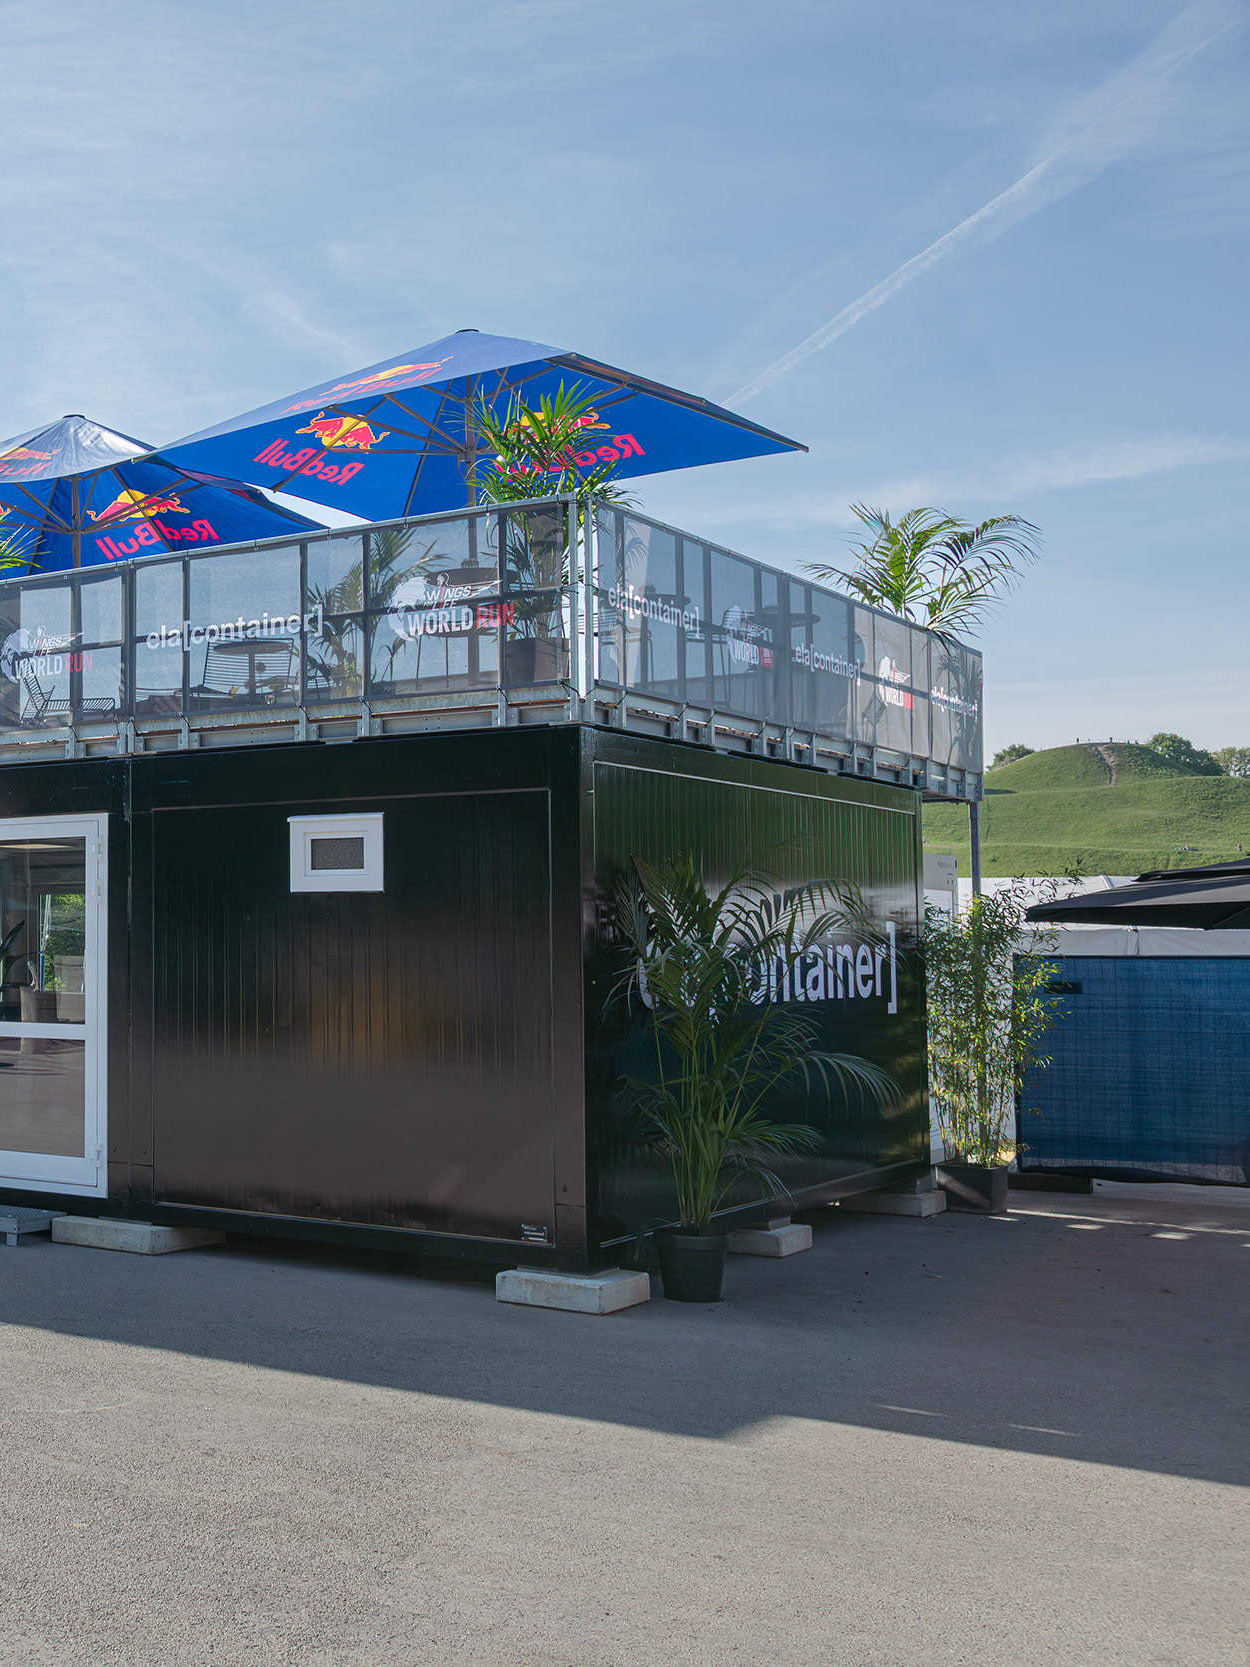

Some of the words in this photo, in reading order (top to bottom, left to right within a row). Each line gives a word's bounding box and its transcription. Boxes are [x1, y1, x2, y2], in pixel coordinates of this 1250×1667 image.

[426, 585, 472, 601] WINGS
[432, 598, 459, 610] LIFE
[146, 604, 324, 652] ela[container]
[407, 607, 474, 637] WORLD
[476, 602, 515, 629] RUN
[64, 651, 93, 673] RUN
[733, 638, 760, 665] WORLD
